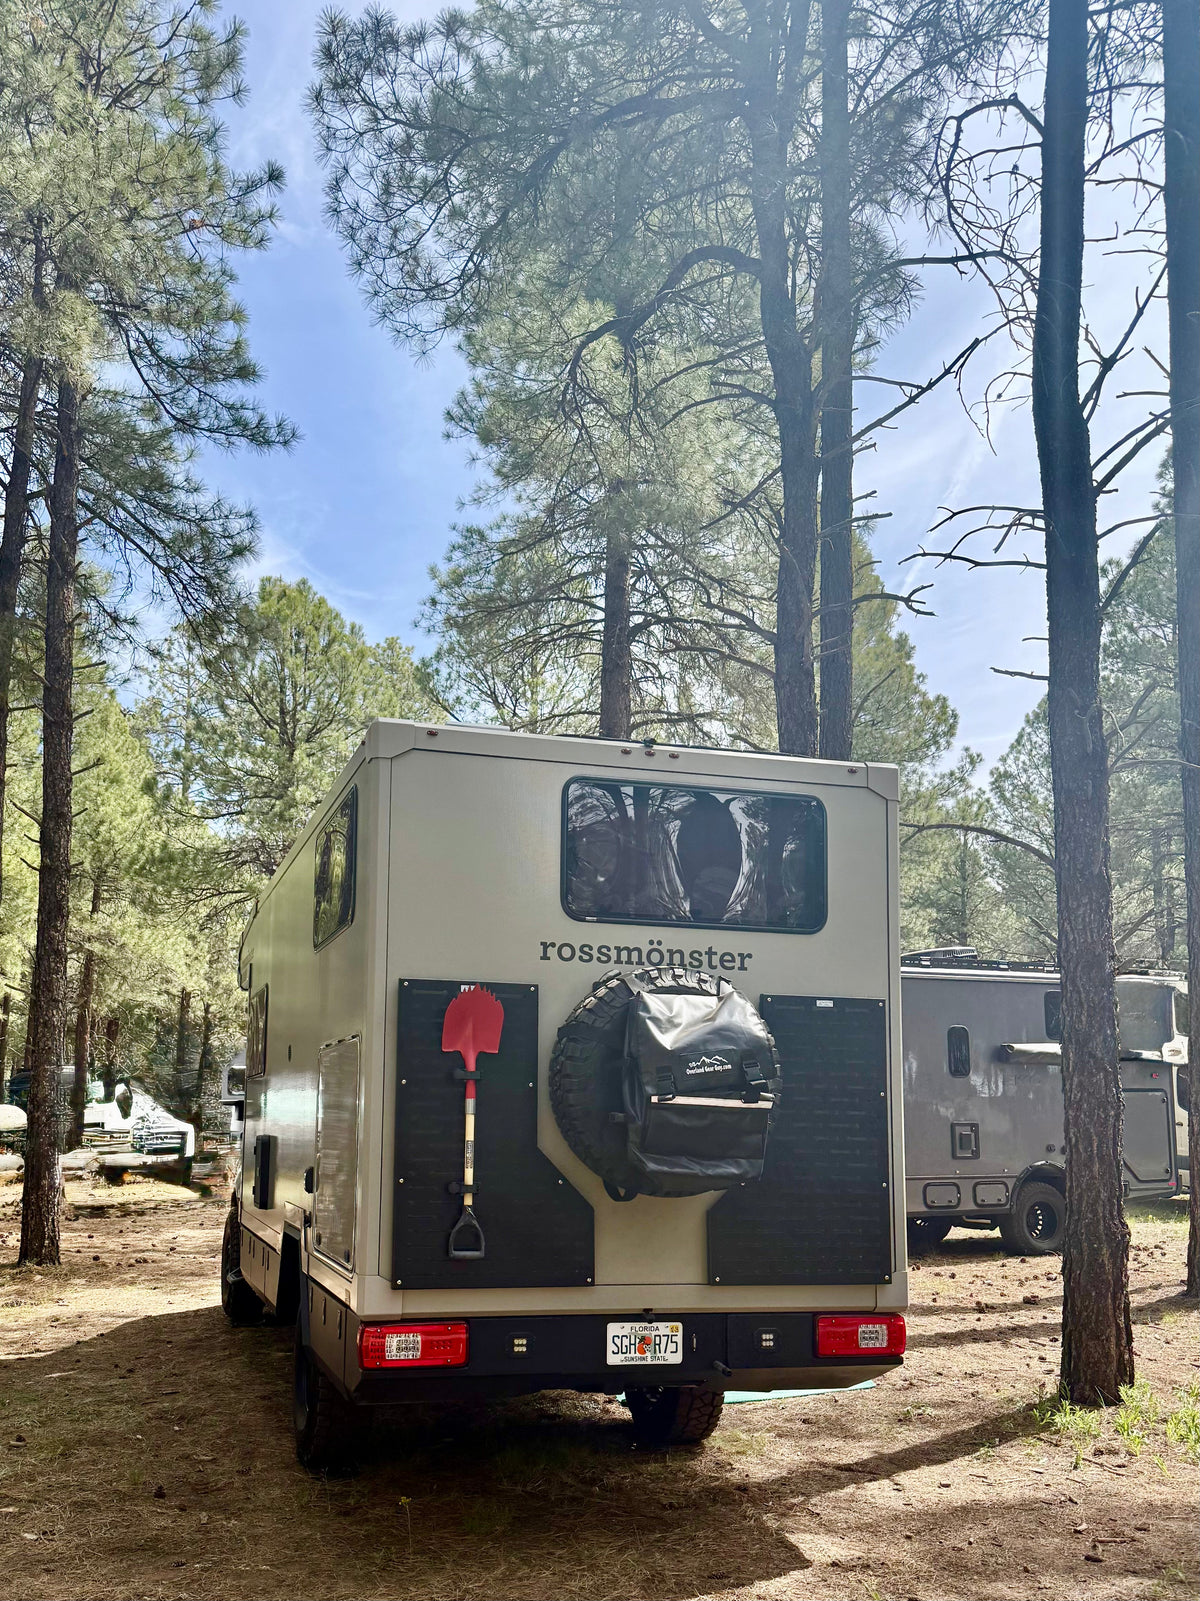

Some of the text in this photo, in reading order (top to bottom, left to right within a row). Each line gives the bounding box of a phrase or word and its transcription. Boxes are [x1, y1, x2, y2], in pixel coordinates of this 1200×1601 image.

[539, 939, 753, 971] rossmönster
[612, 1334, 679, 1355] SGH R75
[623, 1355, 649, 1363] SUNSHINE
